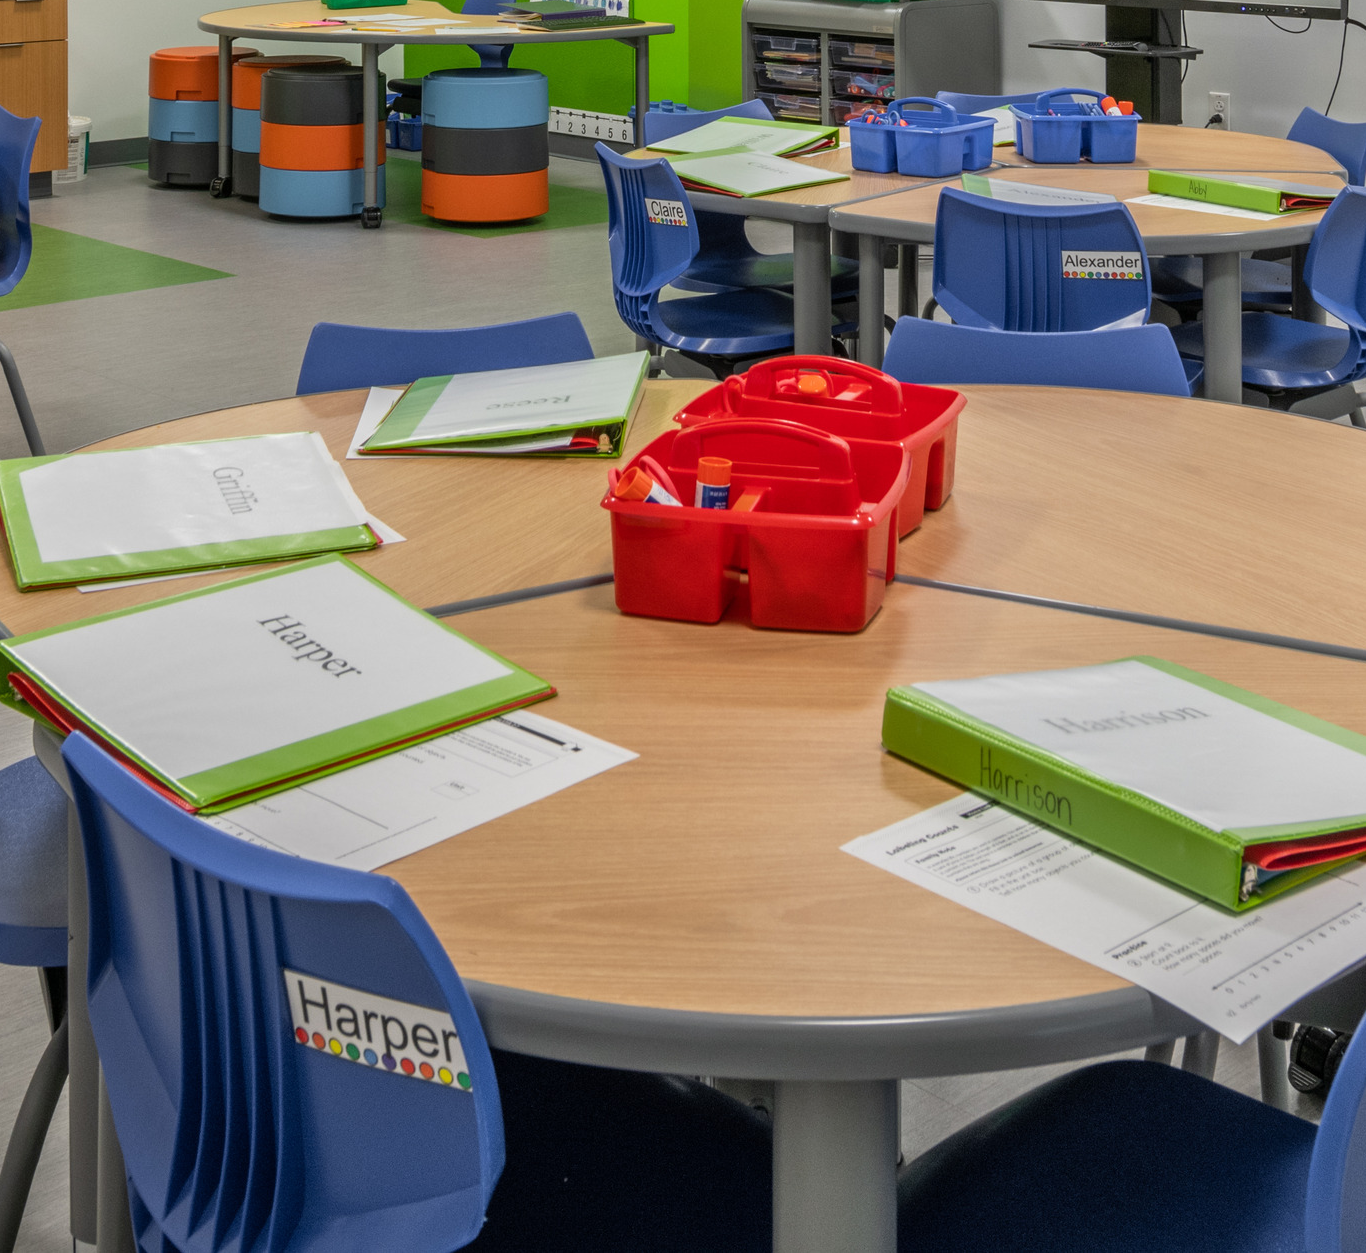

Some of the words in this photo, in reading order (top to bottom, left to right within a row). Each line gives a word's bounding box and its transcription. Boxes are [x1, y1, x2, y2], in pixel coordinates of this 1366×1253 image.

[651, 201, 683, 218] Claire
[1189, 180, 1208, 198] Abby
[1065, 254, 1139, 268] Alexander
[213, 466, 259, 515] Griffin
[257, 614, 361, 680] Harper
[1043, 701, 1210, 738] Harrison
[978, 747, 1073, 826] Harrison
[298, 980, 457, 1062] Harper
